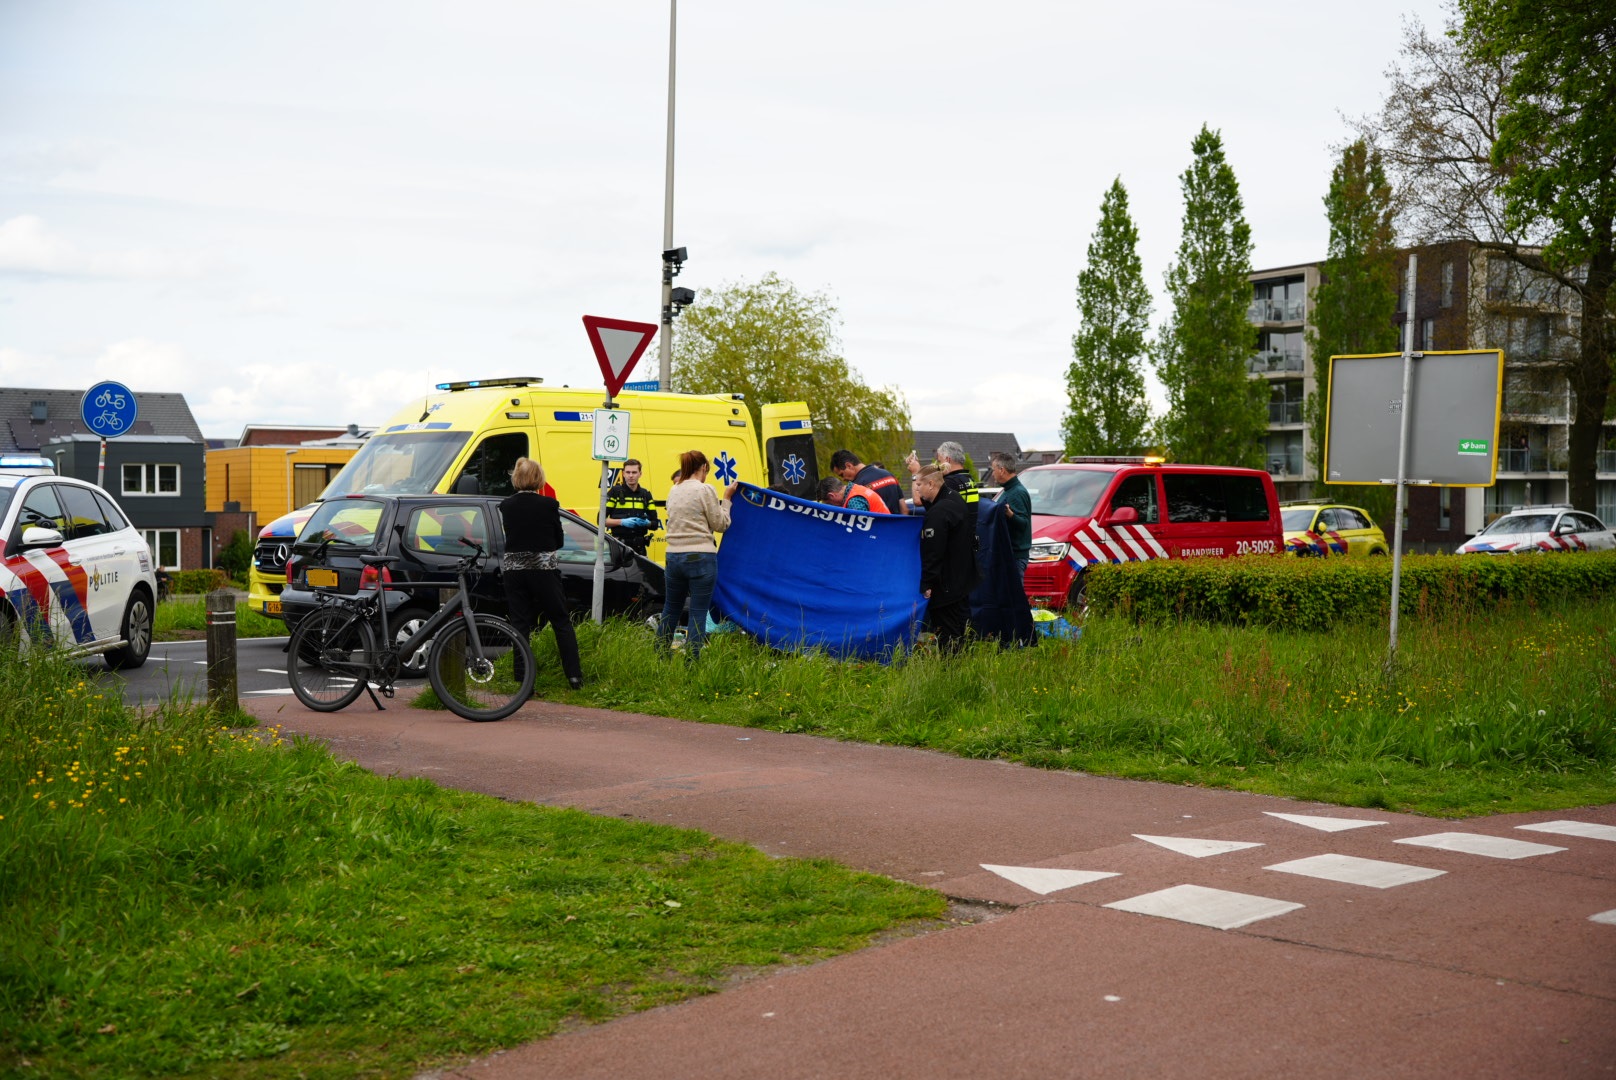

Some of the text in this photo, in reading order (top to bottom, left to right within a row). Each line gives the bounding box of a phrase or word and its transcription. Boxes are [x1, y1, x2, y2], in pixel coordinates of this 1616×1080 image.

[606, 440, 616, 448] 14
[1181, 548, 1224, 557] BRANDWEER
[1236, 540, 1275, 554] 20-5092
[89, 571, 119, 592] POLITIE
